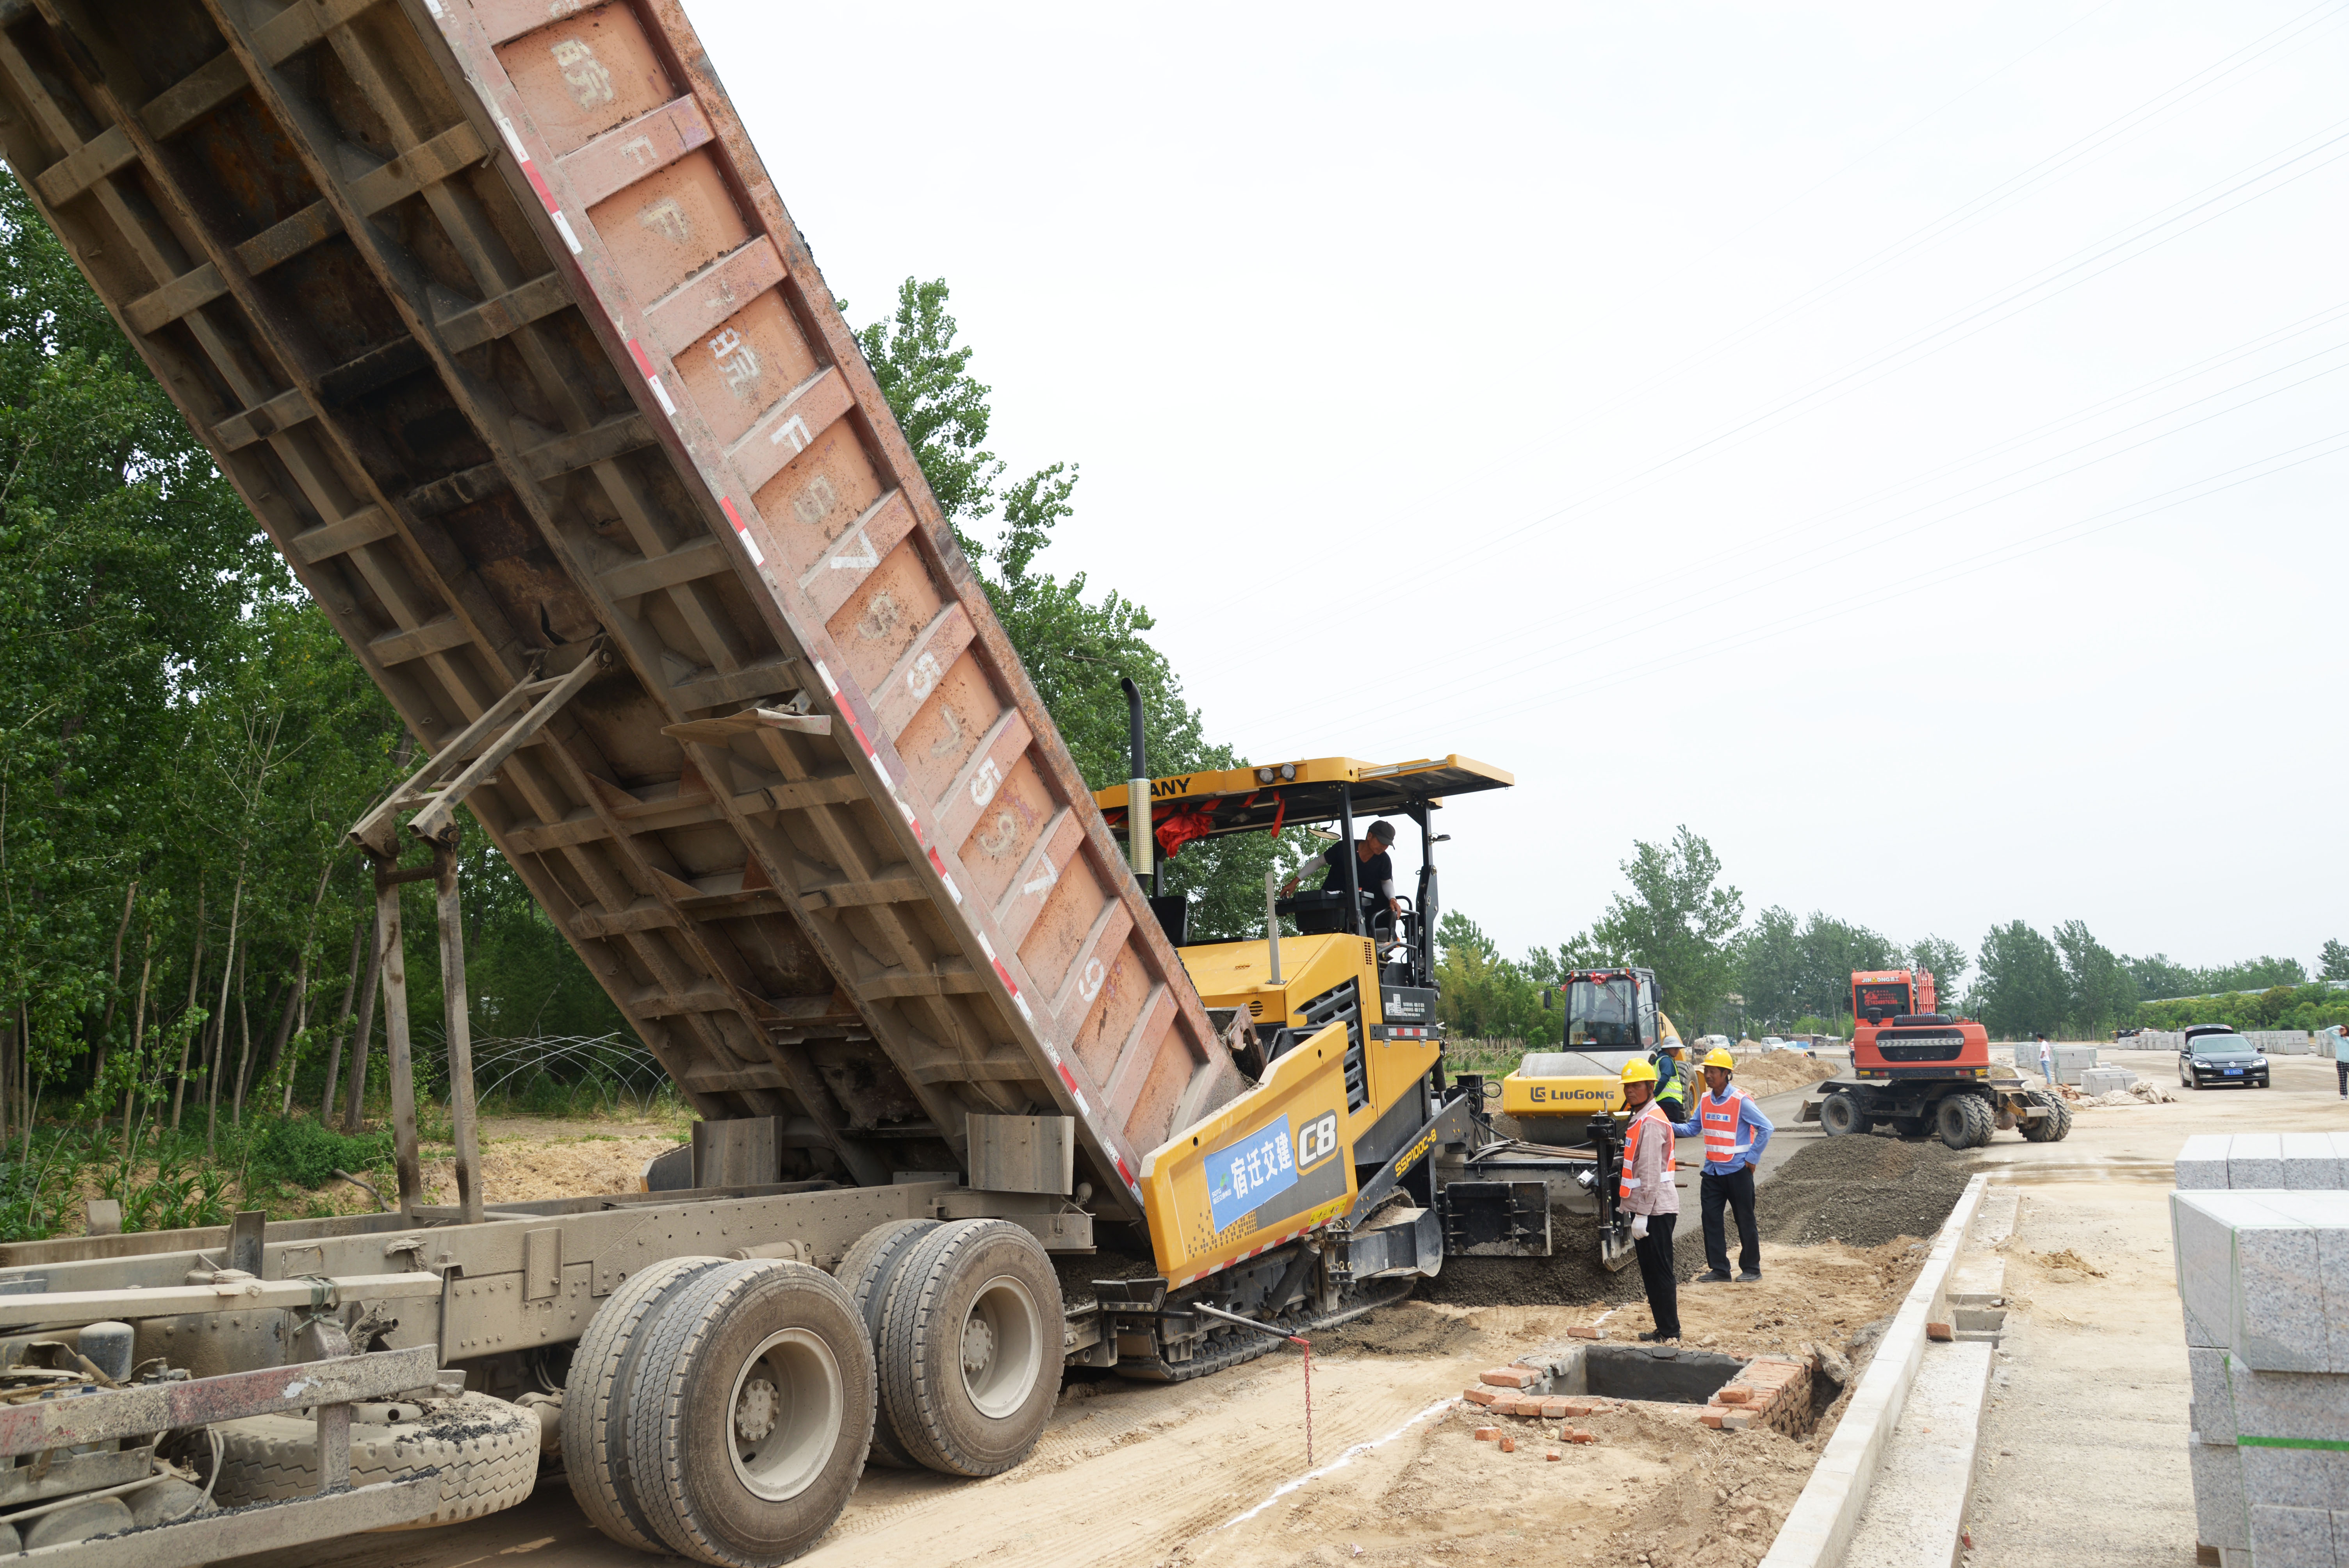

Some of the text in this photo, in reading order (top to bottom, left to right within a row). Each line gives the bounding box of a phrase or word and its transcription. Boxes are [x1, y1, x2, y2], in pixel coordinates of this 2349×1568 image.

[770, 413, 812, 453] F
[830, 529, 880, 568] 7
[1151, 777, 1191, 797] ANY
[1231, 1131, 1292, 1199] 宿迁交建
[1299, 1115, 1336, 1166] C8
[1395, 1128, 1437, 1177] SSP100C-8
[1212, 1188, 1221, 1198] SQTG
